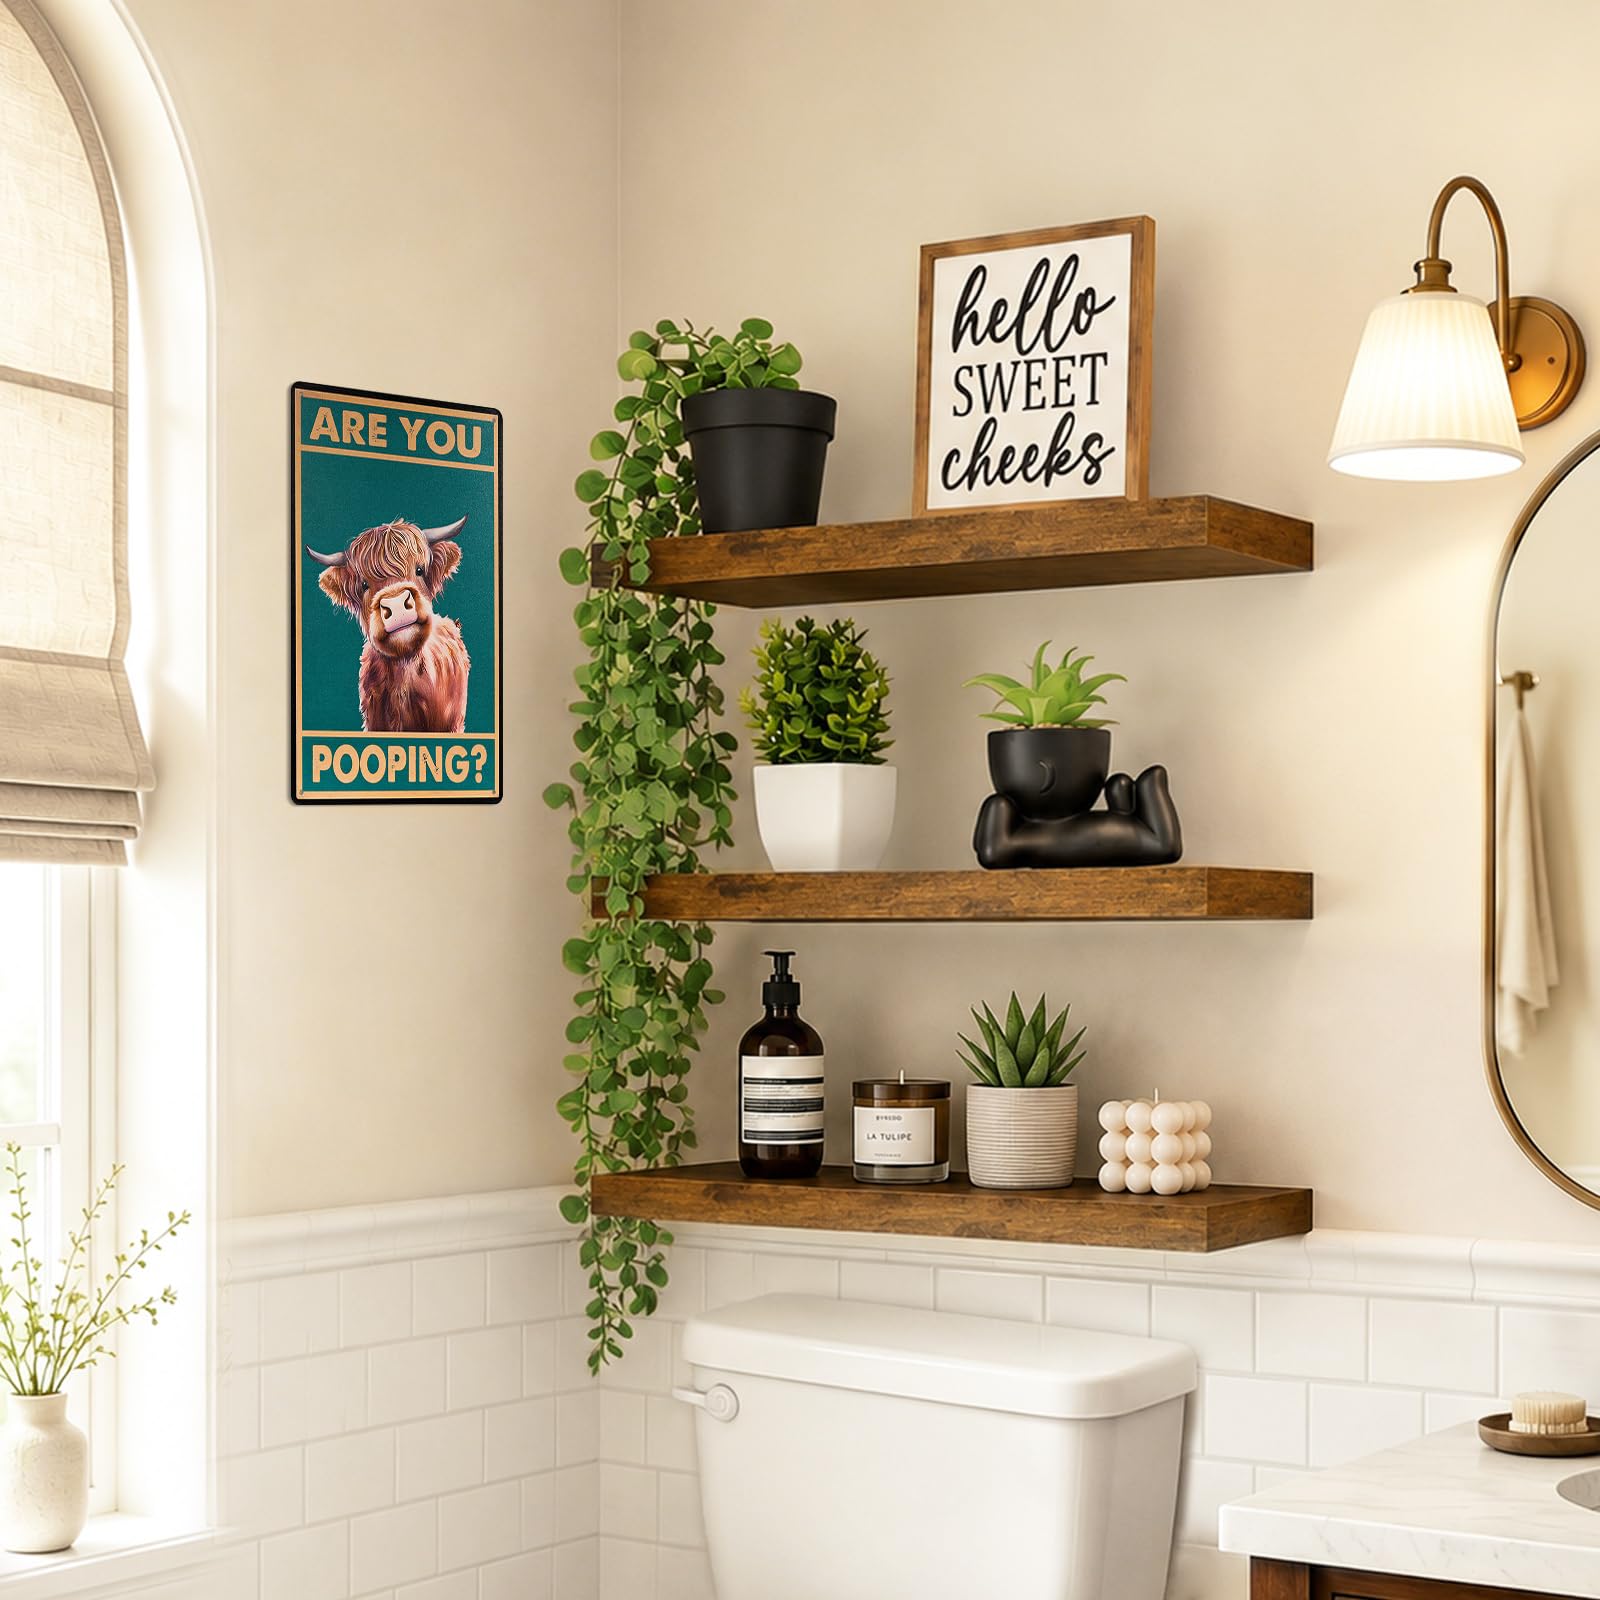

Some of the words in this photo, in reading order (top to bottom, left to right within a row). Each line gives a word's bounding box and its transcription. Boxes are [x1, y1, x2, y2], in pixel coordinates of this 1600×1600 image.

[952, 253, 1116, 356] hello
[952, 352, 1108, 417] SWEET
[309, 406, 388, 448] ARE
[399, 416, 482, 459] YOU
[941, 411, 1116, 491] cheeks
[311, 743, 487, 784] POOPING?
[880, 1133, 913, 1141] TULIPE
